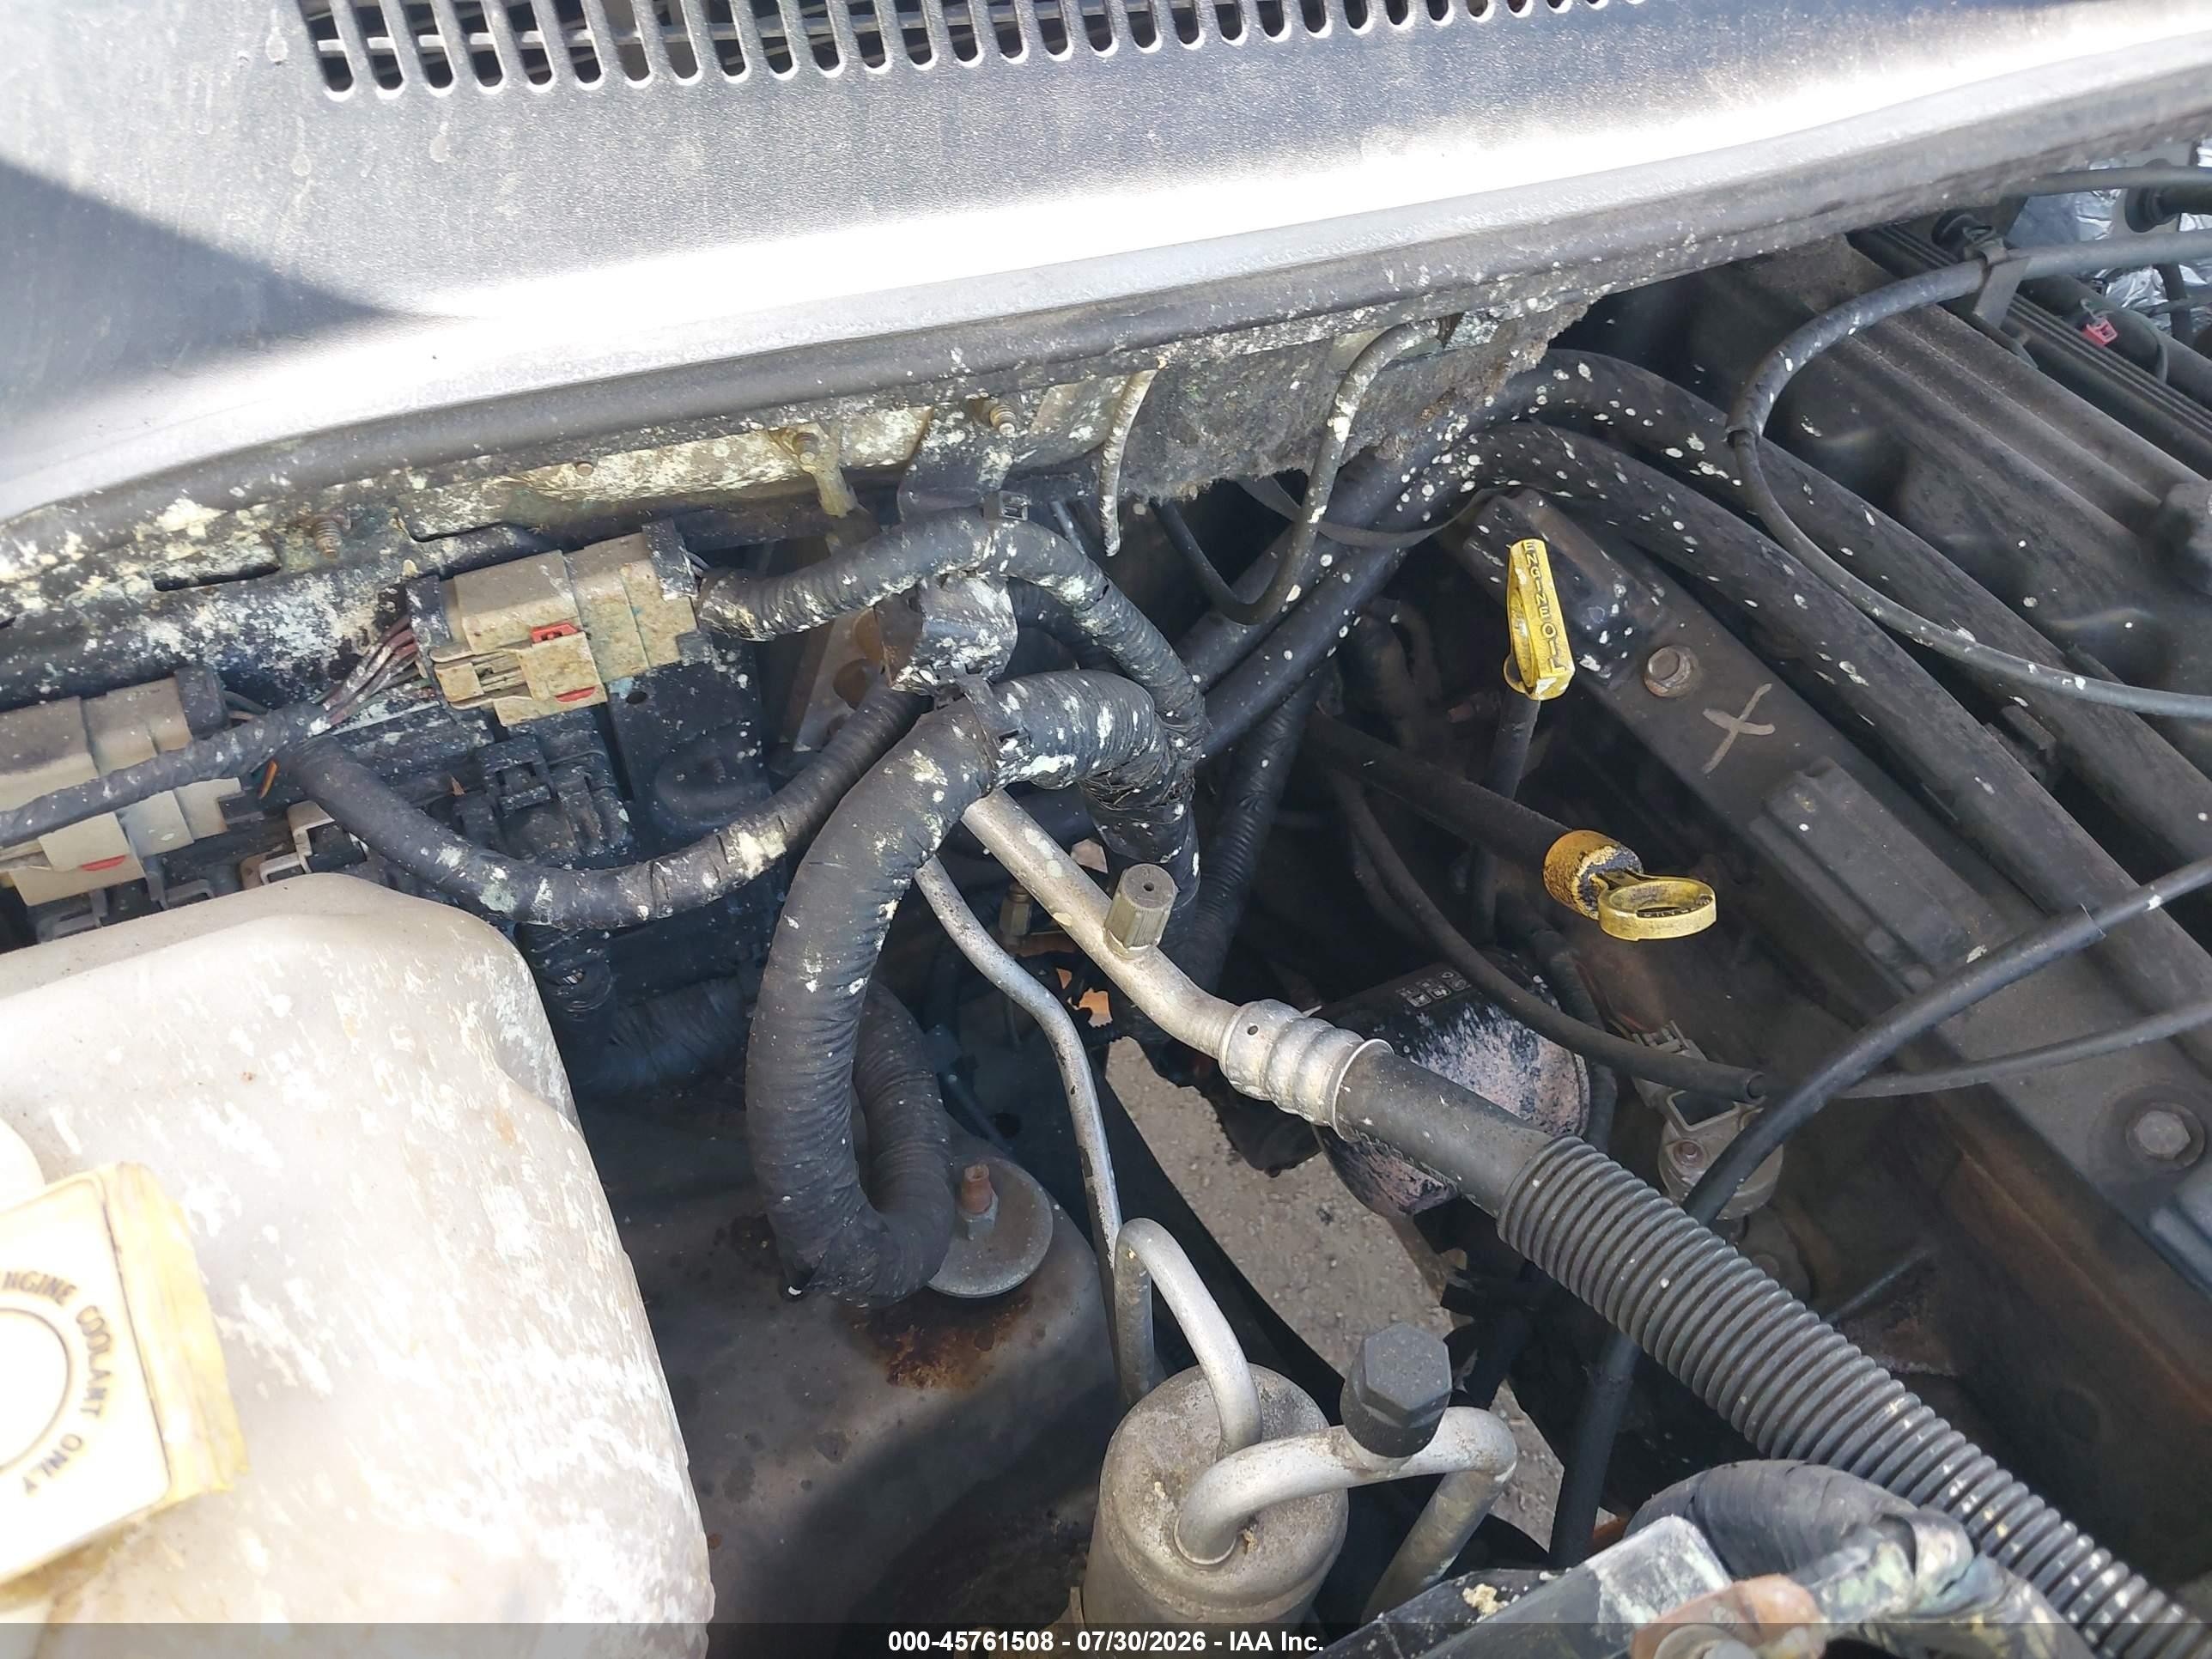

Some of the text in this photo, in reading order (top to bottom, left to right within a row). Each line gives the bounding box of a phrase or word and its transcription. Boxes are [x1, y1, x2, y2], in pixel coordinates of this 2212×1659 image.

[1522, 541, 1566, 672] ENGINE OIL
[0, 1270, 112, 1494] NGINE COOLANT ONLY
